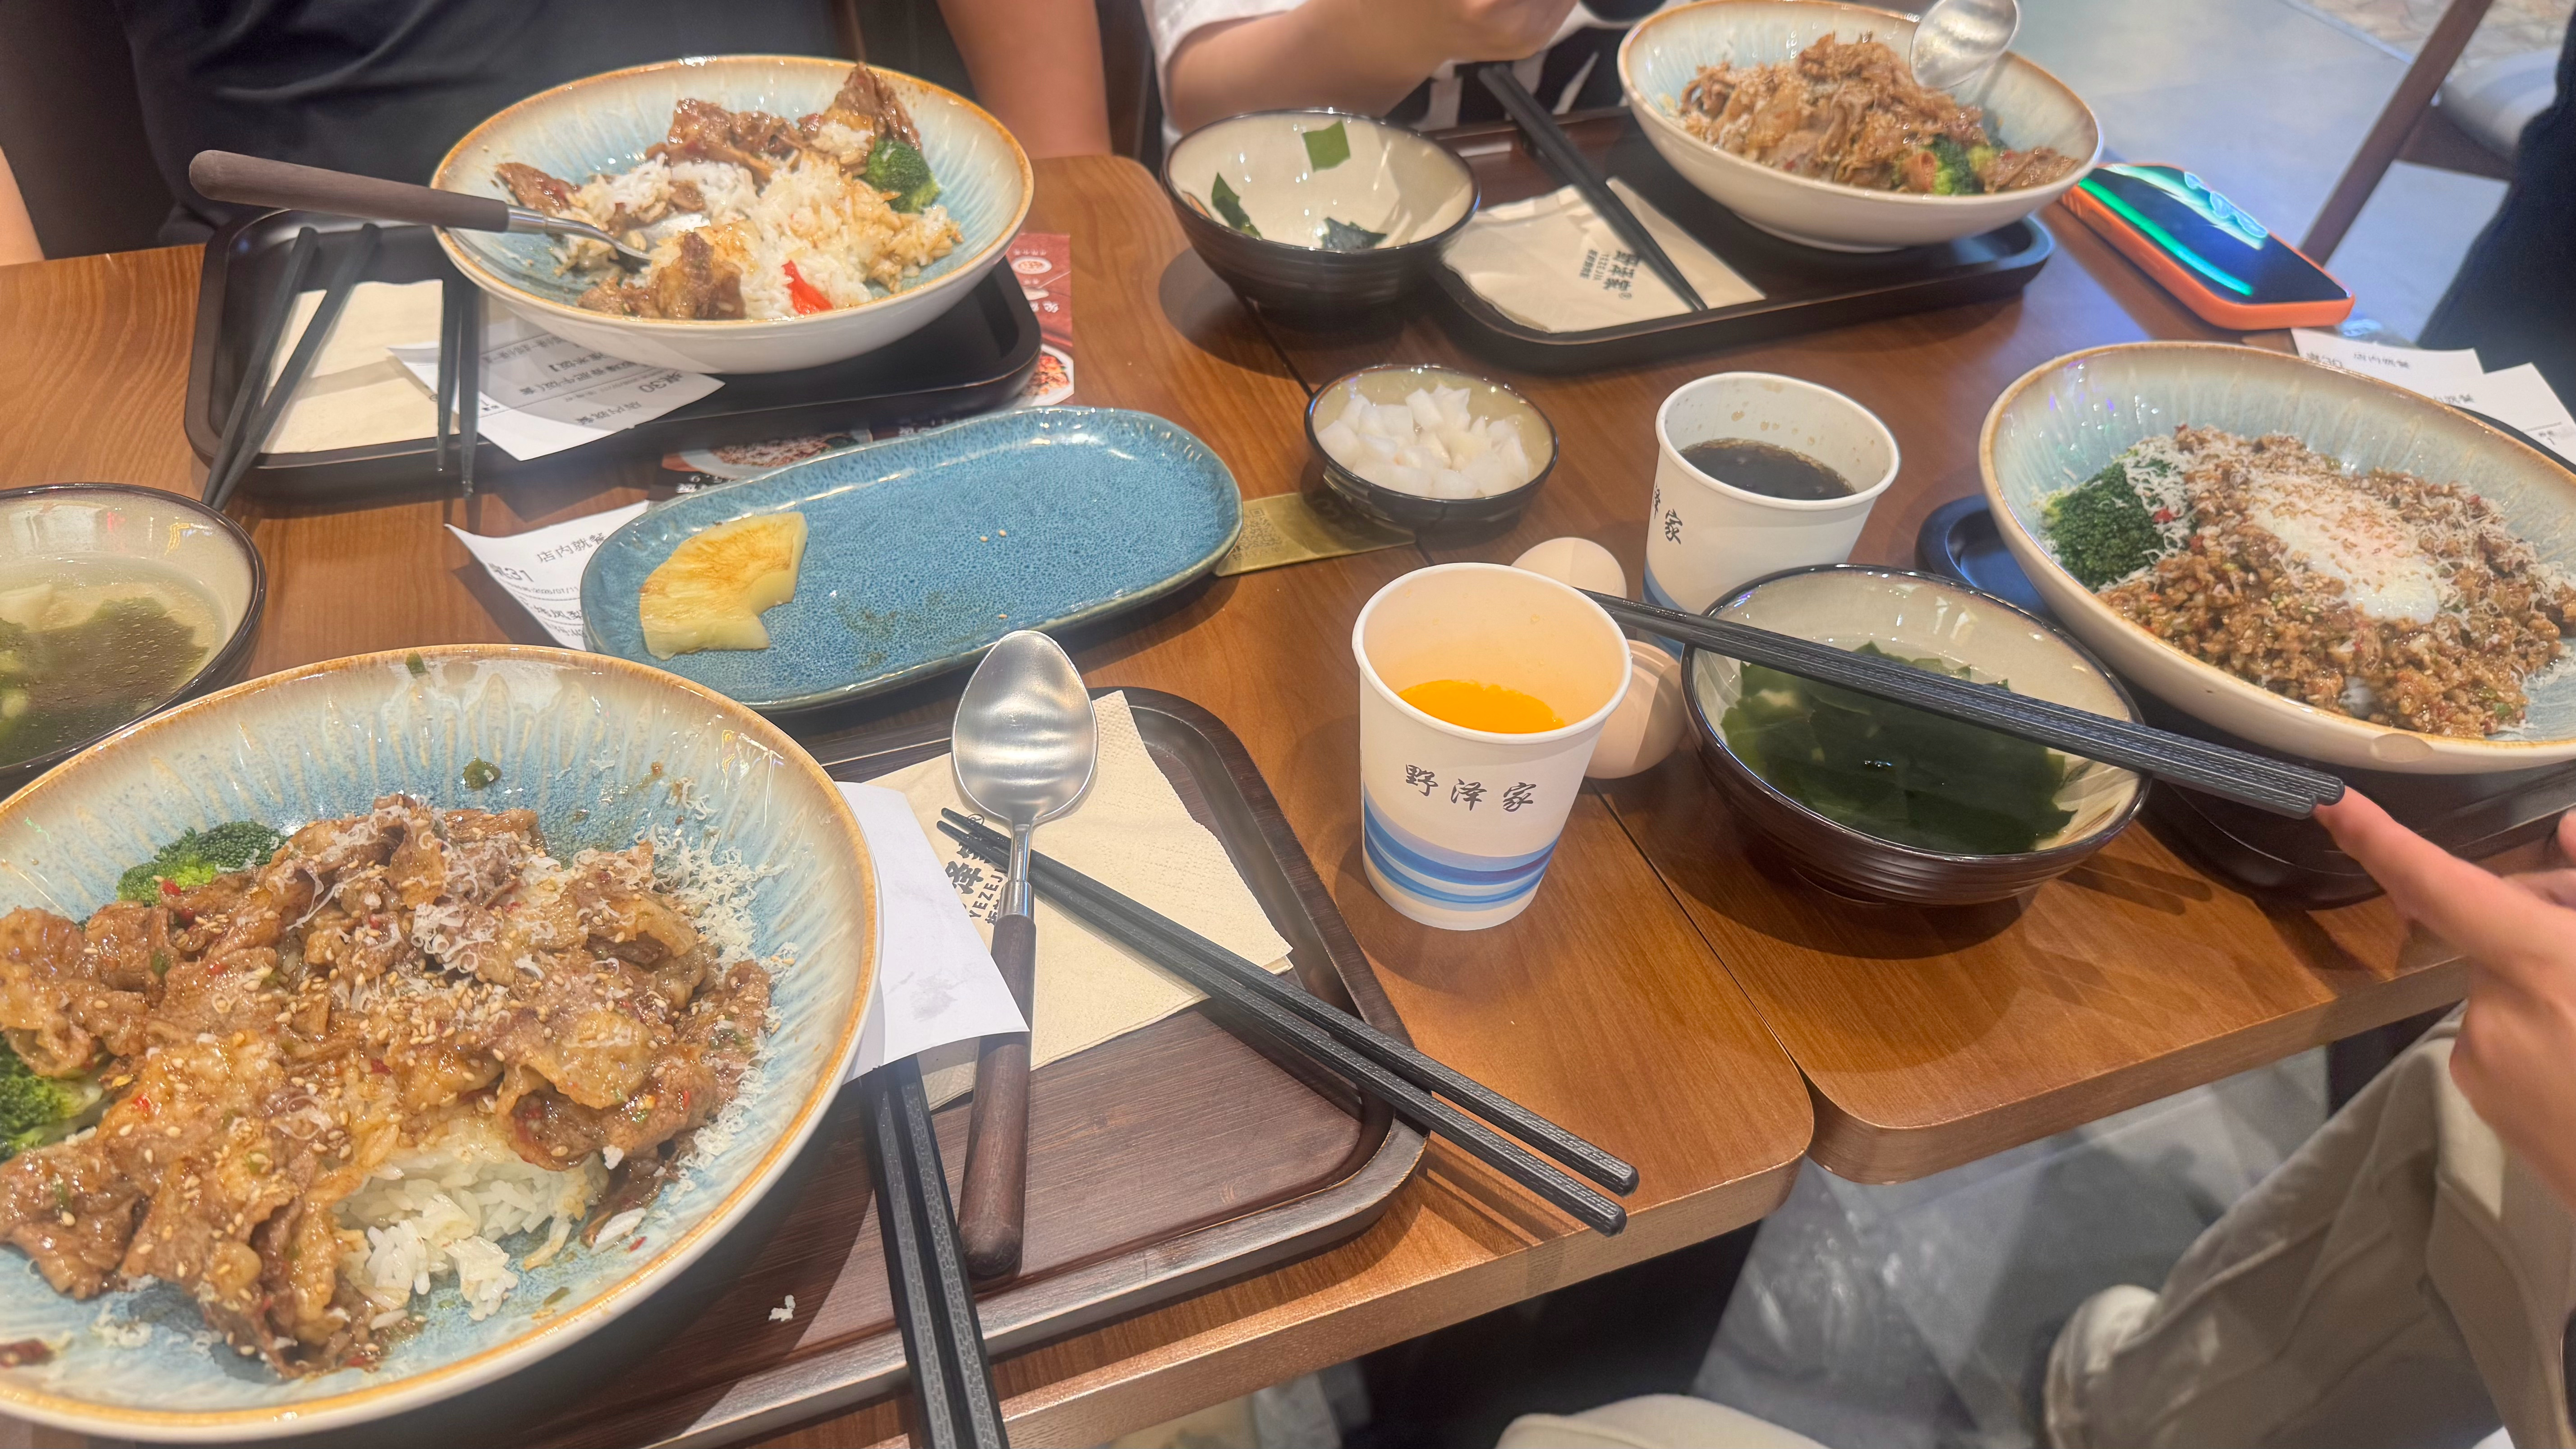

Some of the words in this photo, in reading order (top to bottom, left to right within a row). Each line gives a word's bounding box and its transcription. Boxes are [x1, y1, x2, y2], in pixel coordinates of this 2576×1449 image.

[537, 532, 607, 563] 店内就餐
[1405, 764, 1537, 812] 野泽家
